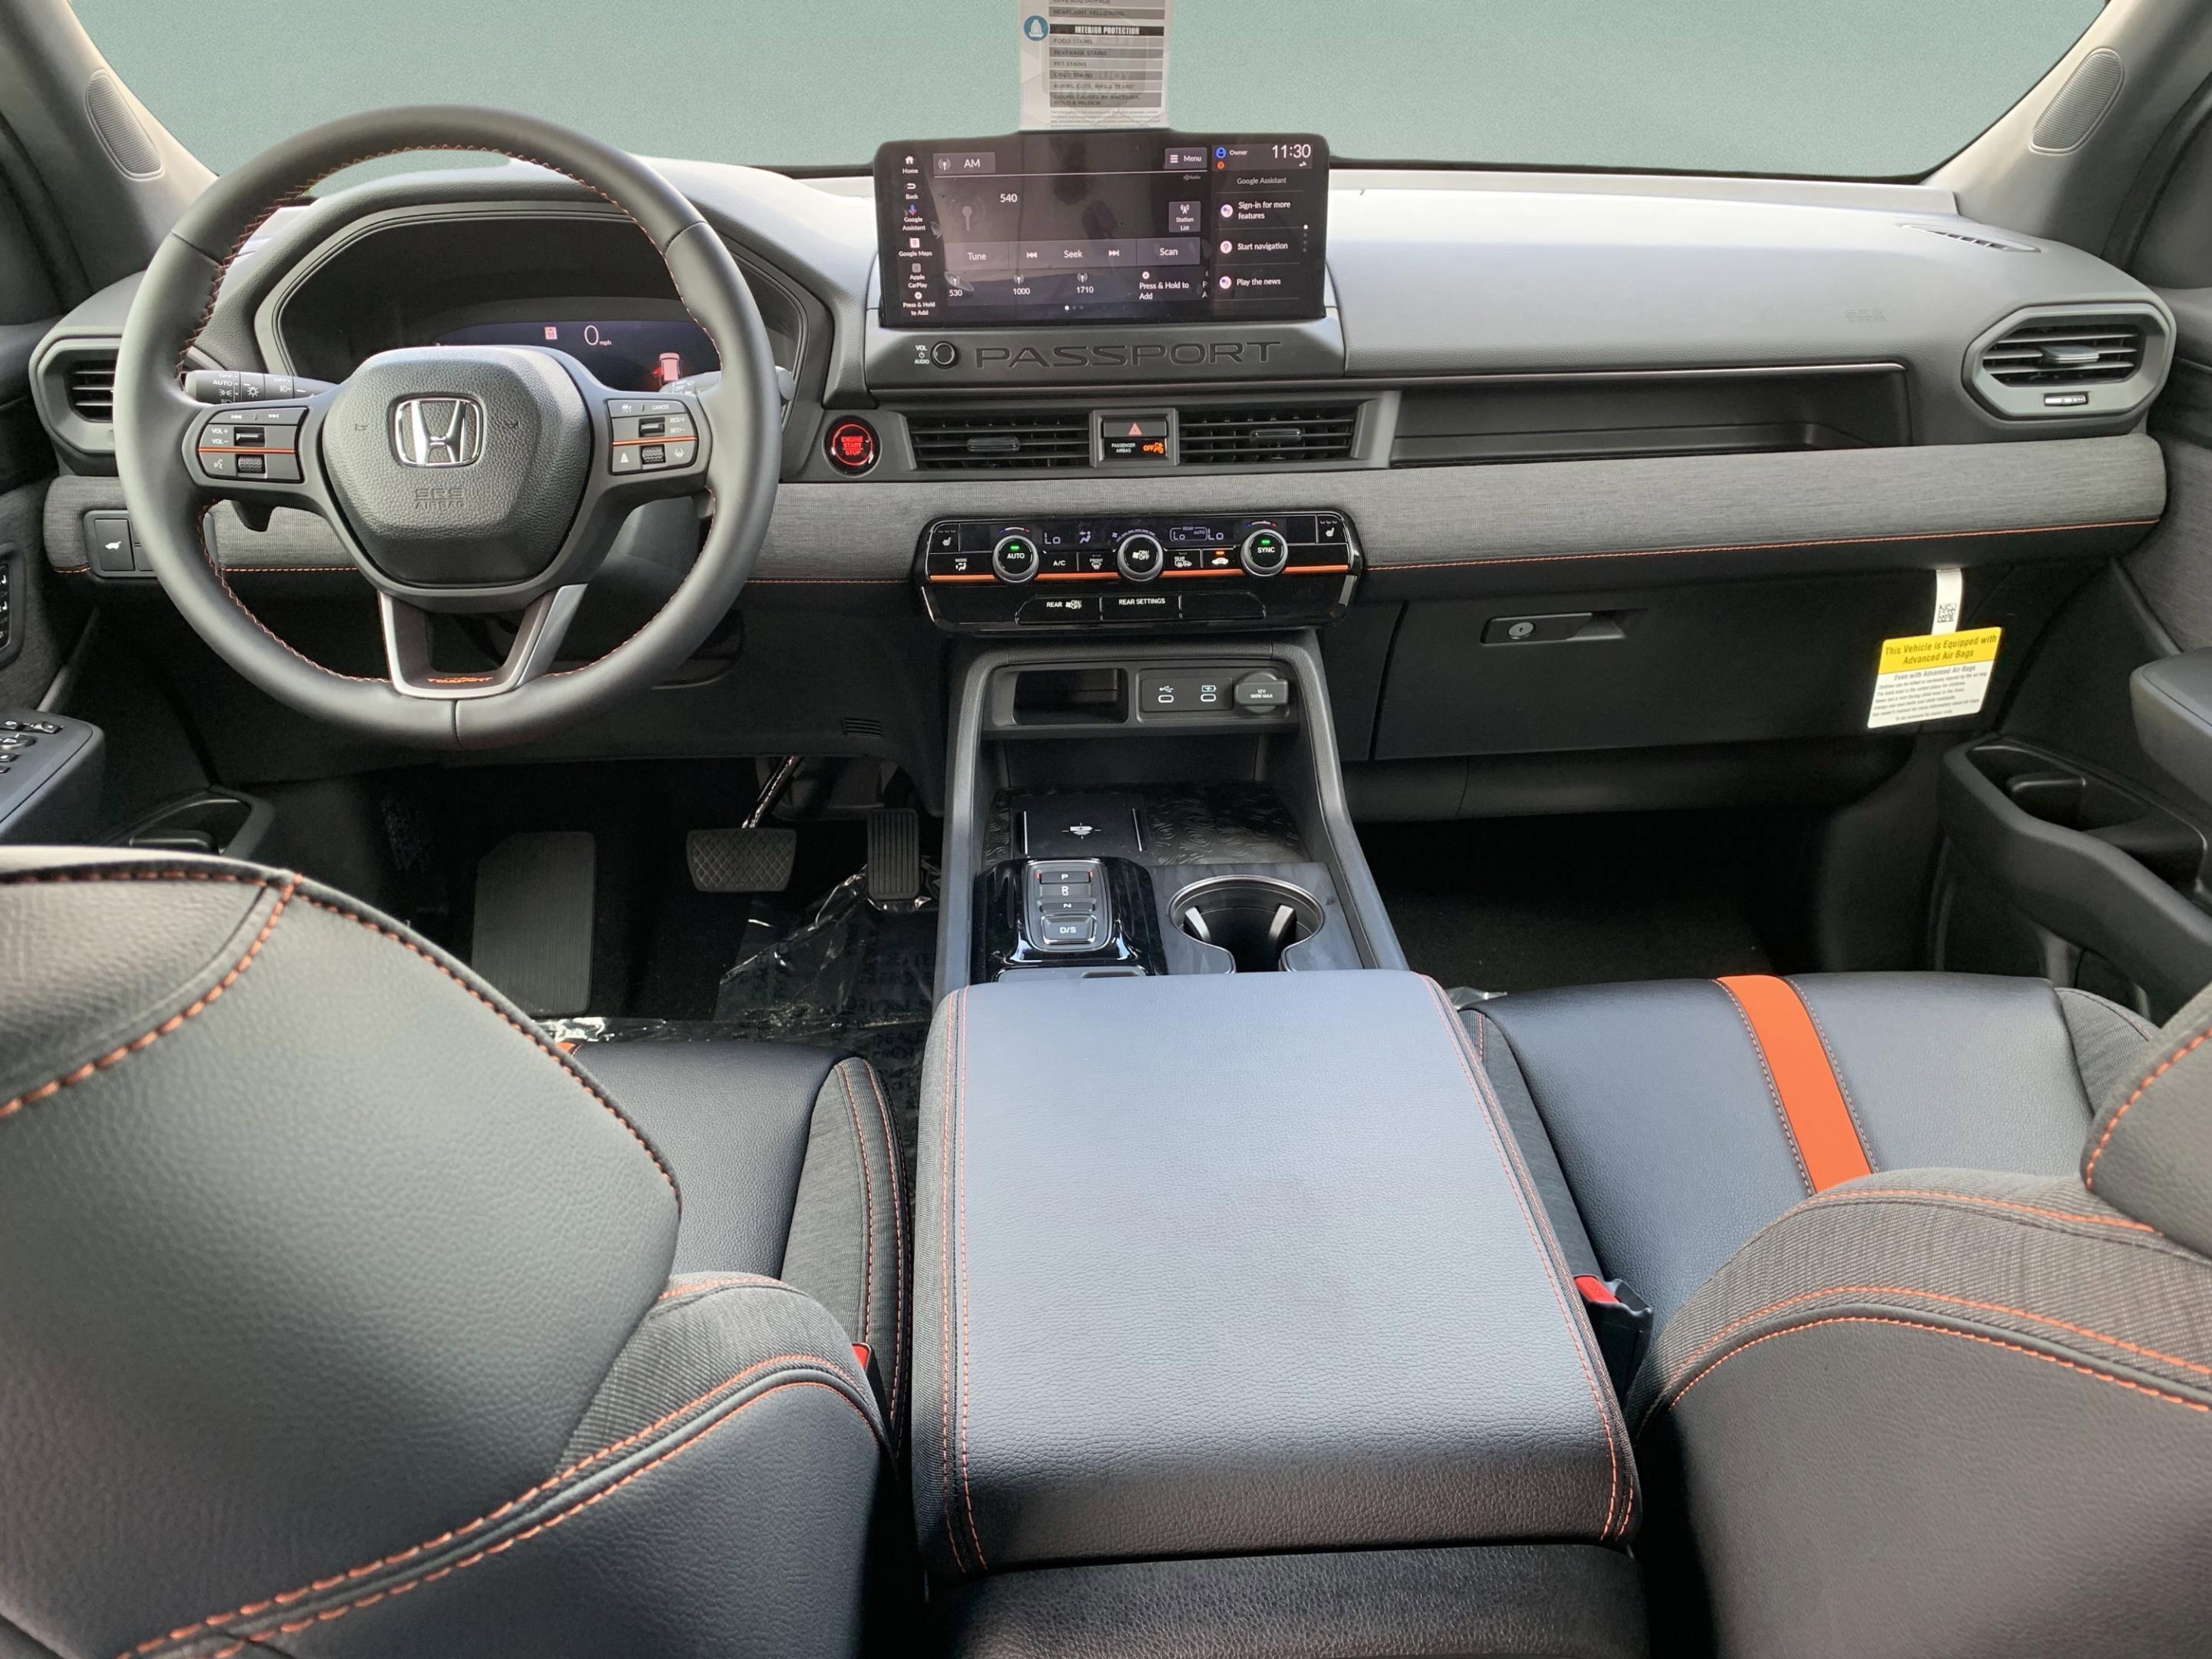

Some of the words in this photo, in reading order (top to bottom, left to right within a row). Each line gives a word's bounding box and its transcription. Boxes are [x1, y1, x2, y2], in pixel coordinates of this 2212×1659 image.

[1075, 25, 1103, 34] INTERIOR
[1103, 26, 1140, 35] PROTECTION
[1272, 144, 1311, 159] 11:30
[964, 159, 981, 168] AM
[1000, 194, 1018, 203] 540
[1238, 201, 1262, 210] Sign-in
[1256, 242, 1288, 252] navigation
[967, 252, 987, 261] Tune
[1064, 250, 1083, 258] Seek
[1237, 278, 1252, 286] Play
[584, 325, 599, 345] 0
[975, 341, 1282, 369] PASSPORT
[416, 488, 463, 499] SRS
[416, 500, 465, 509] AIRBAG
[1885, 646, 1901, 656] This
[1903, 643, 1932, 653] Vehicle
[1934, 641, 1941, 650] is
[1943, 637, 1979, 649] Equipped
[1980, 634, 1997, 644] with
[1902, 653, 1940, 665] Advanced
[1942, 651, 1954, 659] Air
[1955, 649, 1974, 659] Bags
[1923, 668, 1951, 677] Advanced
